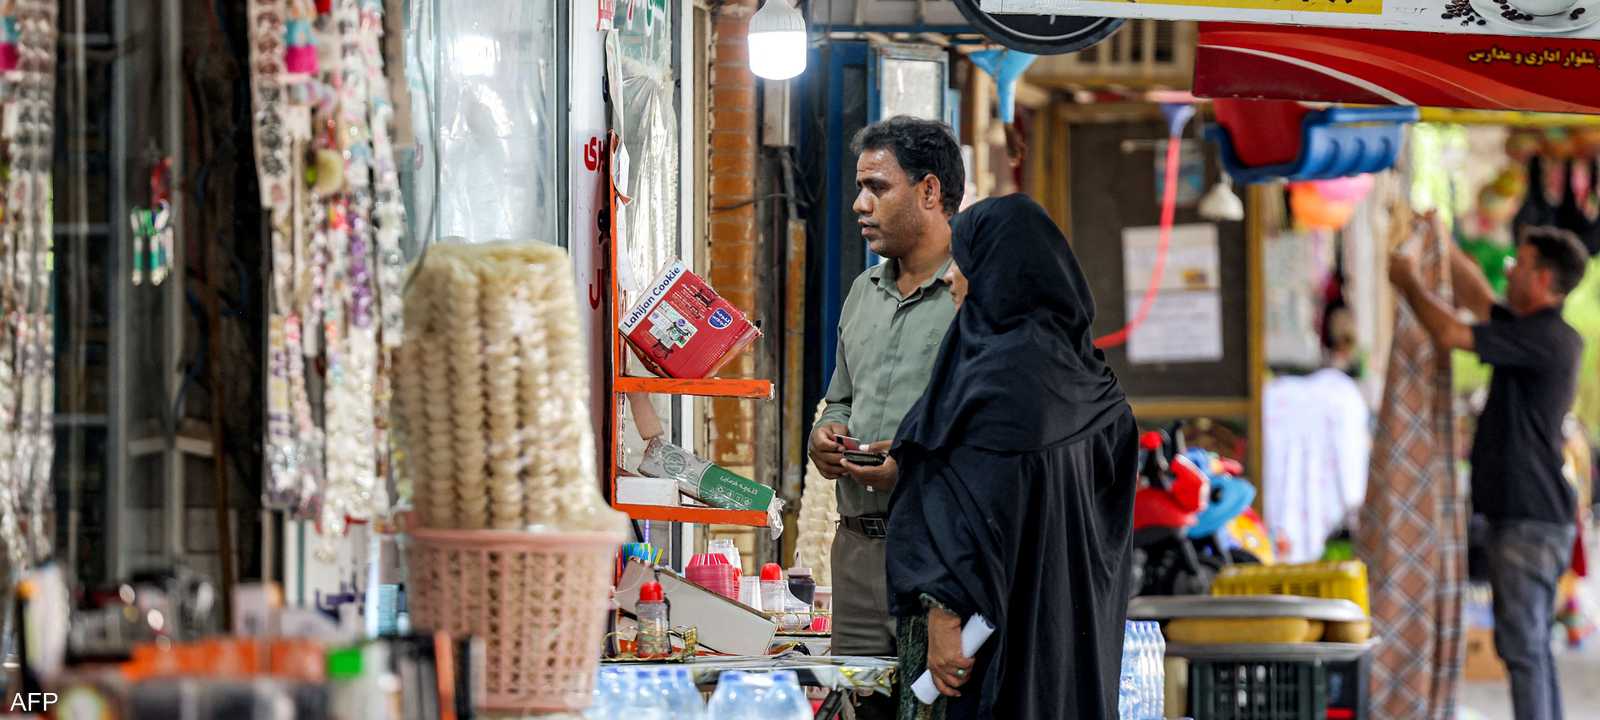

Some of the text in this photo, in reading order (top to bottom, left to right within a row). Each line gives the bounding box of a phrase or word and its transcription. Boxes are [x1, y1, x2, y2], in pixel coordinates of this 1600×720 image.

[1468, 47, 1512, 63] مدارس
[1515, 52, 1522, 64] و
[1524, 50, 1560, 65] اداری
[1563, 51, 1595, 67] شلوار
[623, 267, 681, 329] Lahijan Cookie
